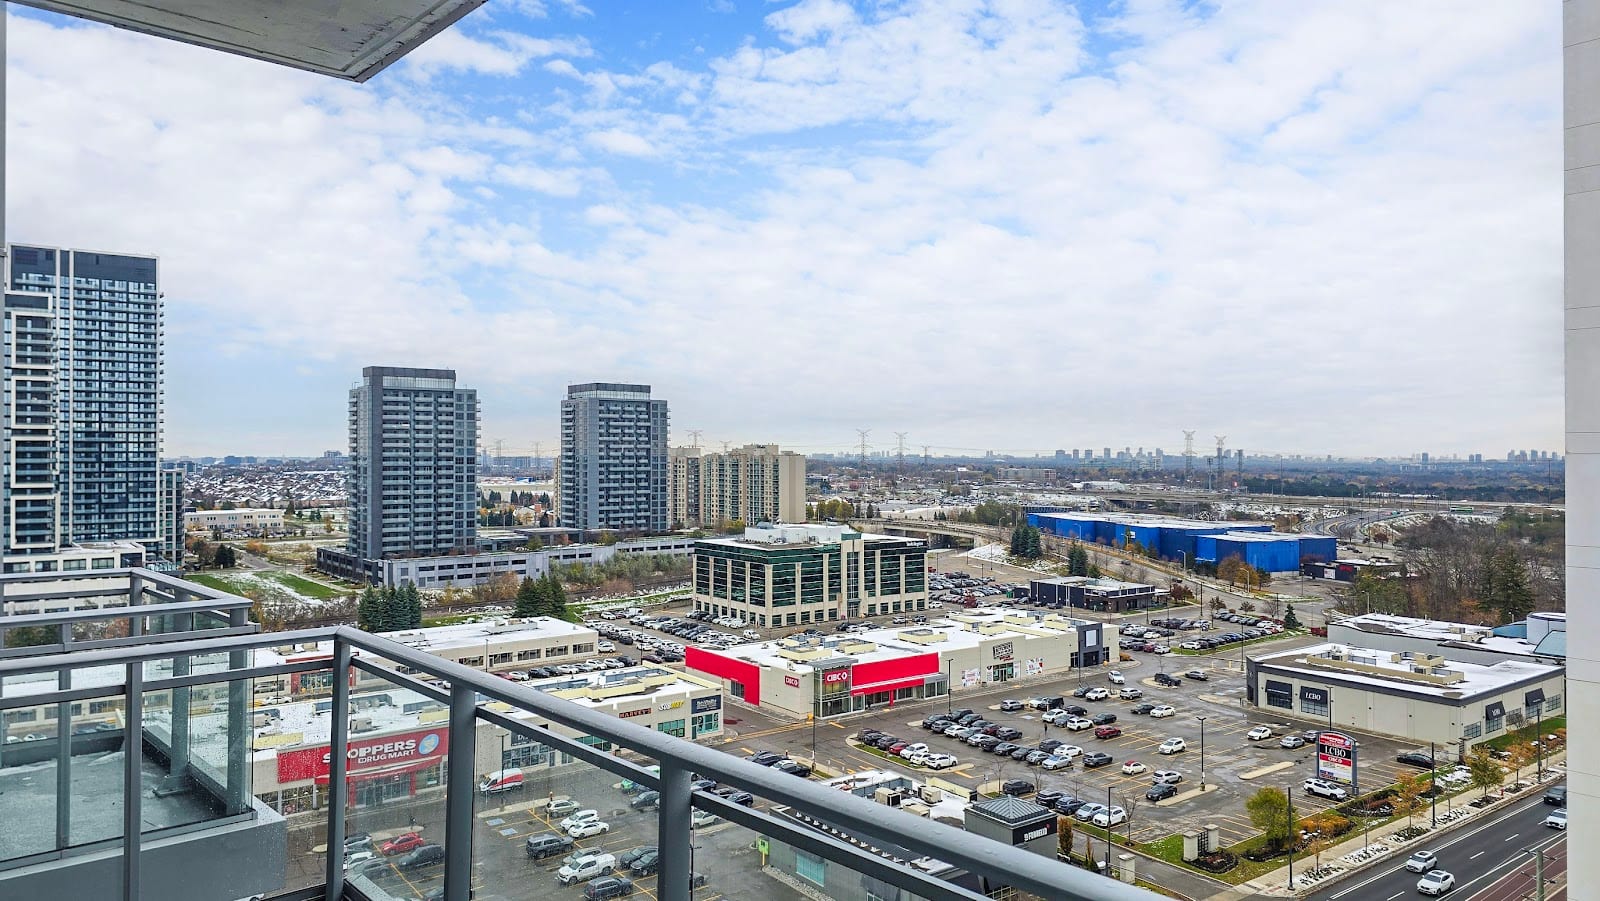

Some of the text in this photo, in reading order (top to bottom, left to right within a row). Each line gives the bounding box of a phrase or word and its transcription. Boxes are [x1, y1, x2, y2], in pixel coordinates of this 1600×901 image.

[827, 673, 841, 682] CIBC
[1306, 692, 1321, 700] LCBO
[322, 740, 416, 763] SOPPERS
[358, 748, 416, 764] DRUG MART
[1325, 746, 1346, 757] LCBO
